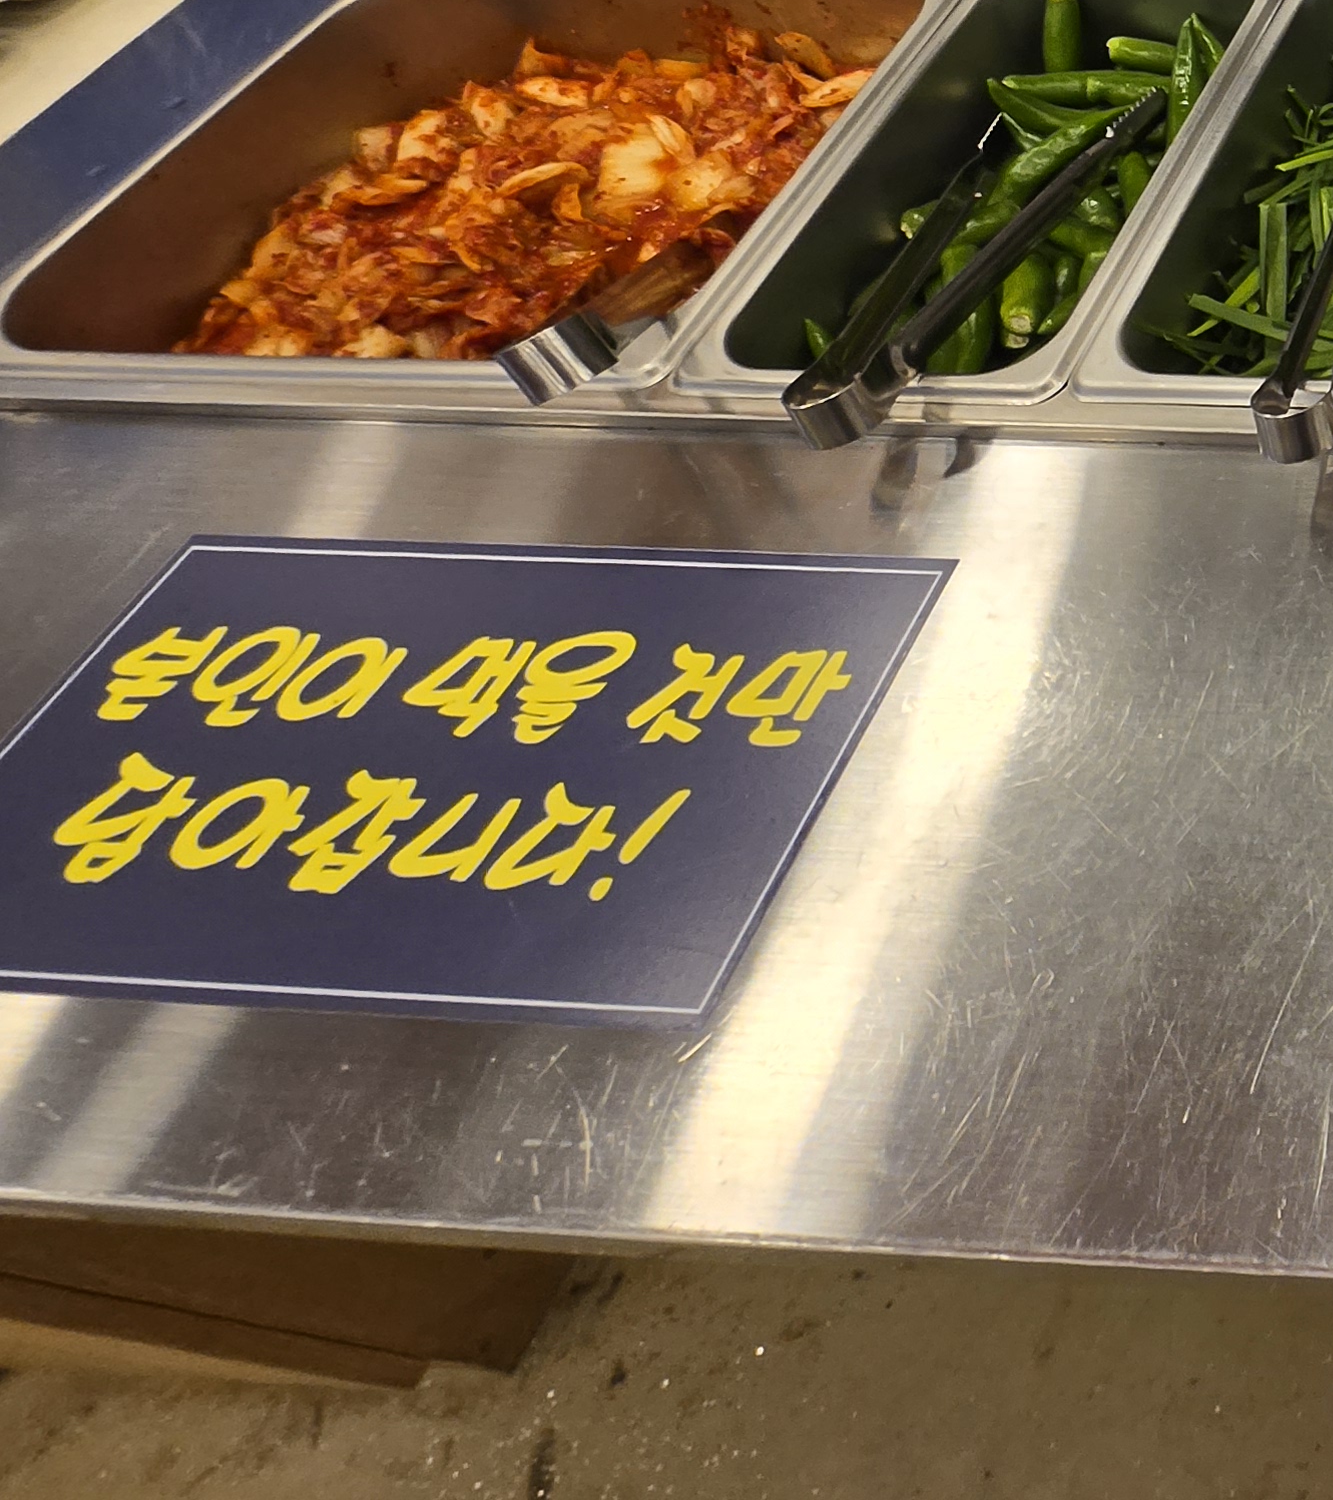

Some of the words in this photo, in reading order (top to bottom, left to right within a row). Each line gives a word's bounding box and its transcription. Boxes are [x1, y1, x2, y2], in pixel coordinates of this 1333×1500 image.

[96, 625, 408, 728] 본인이
[402, 630, 637, 745] 먹을
[626, 642, 853, 747] 것만
[53, 751, 692, 901] 담아갑니다!
